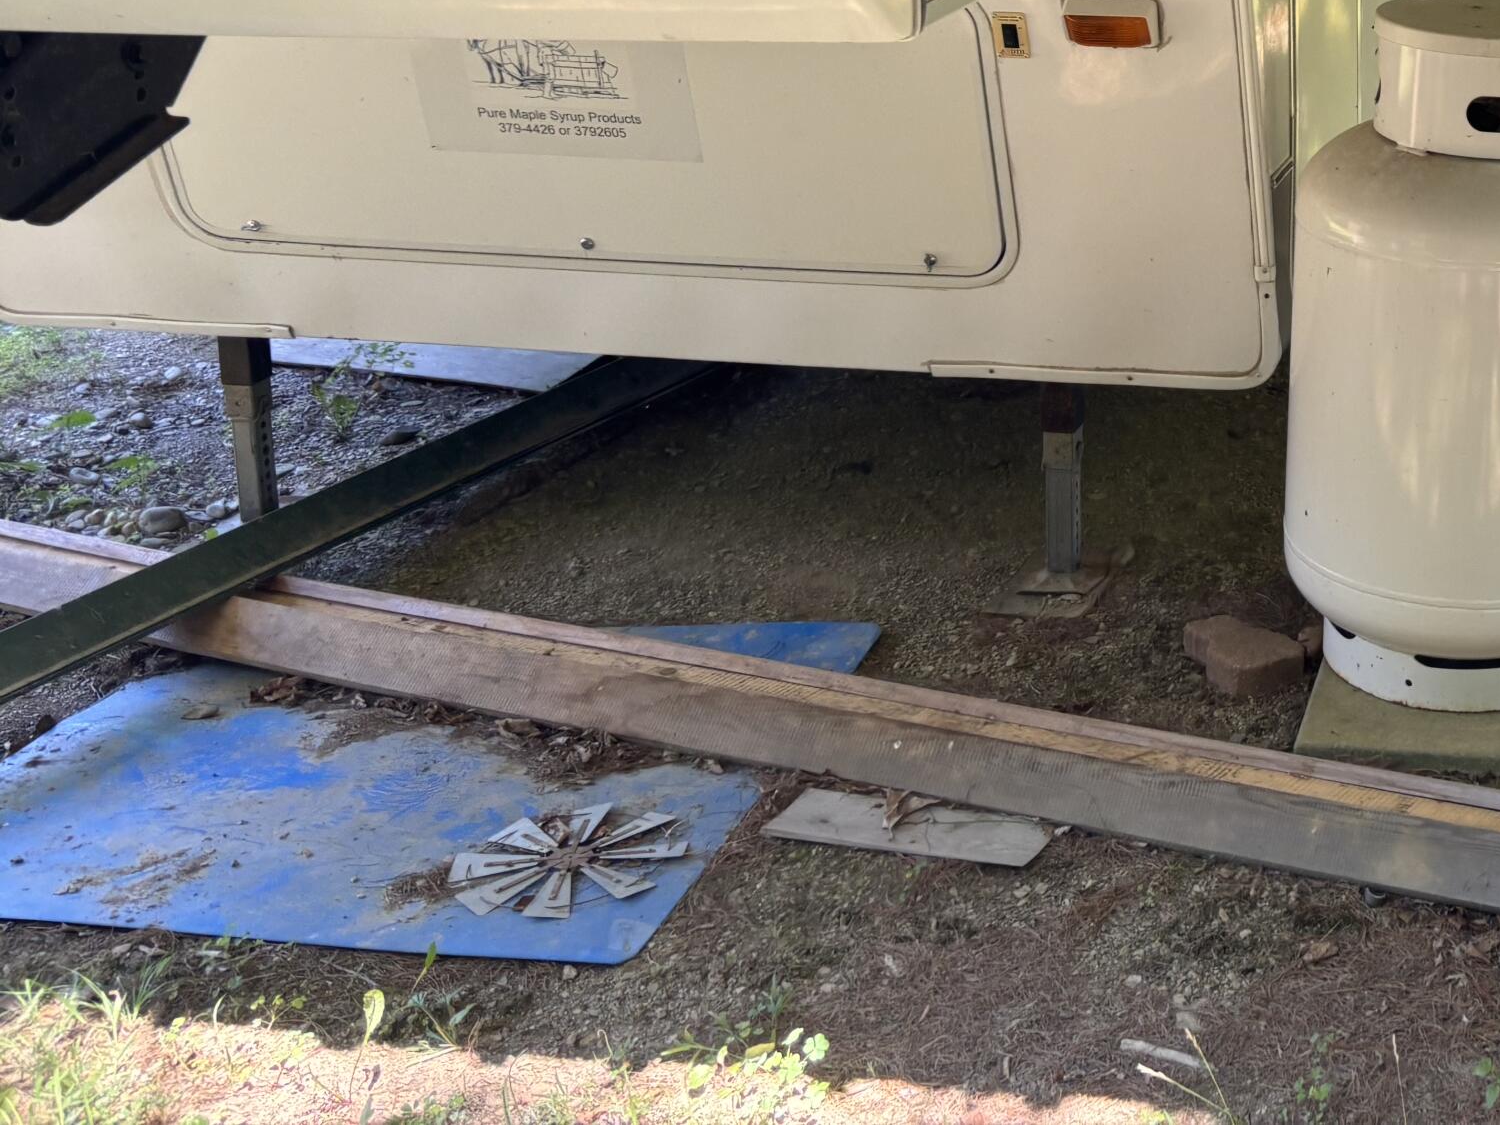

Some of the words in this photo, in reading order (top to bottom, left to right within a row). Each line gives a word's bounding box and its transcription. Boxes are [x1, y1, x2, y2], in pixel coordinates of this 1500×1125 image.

[477, 106, 507, 119] Pure
[509, 108, 547, 121] Maple
[550, 110, 585, 123] Syrup
[588, 111, 642, 125] Products
[498, 122, 556, 135] 379-4426
[558, 125, 571, 135] or
[574, 125, 627, 138] 3792605
